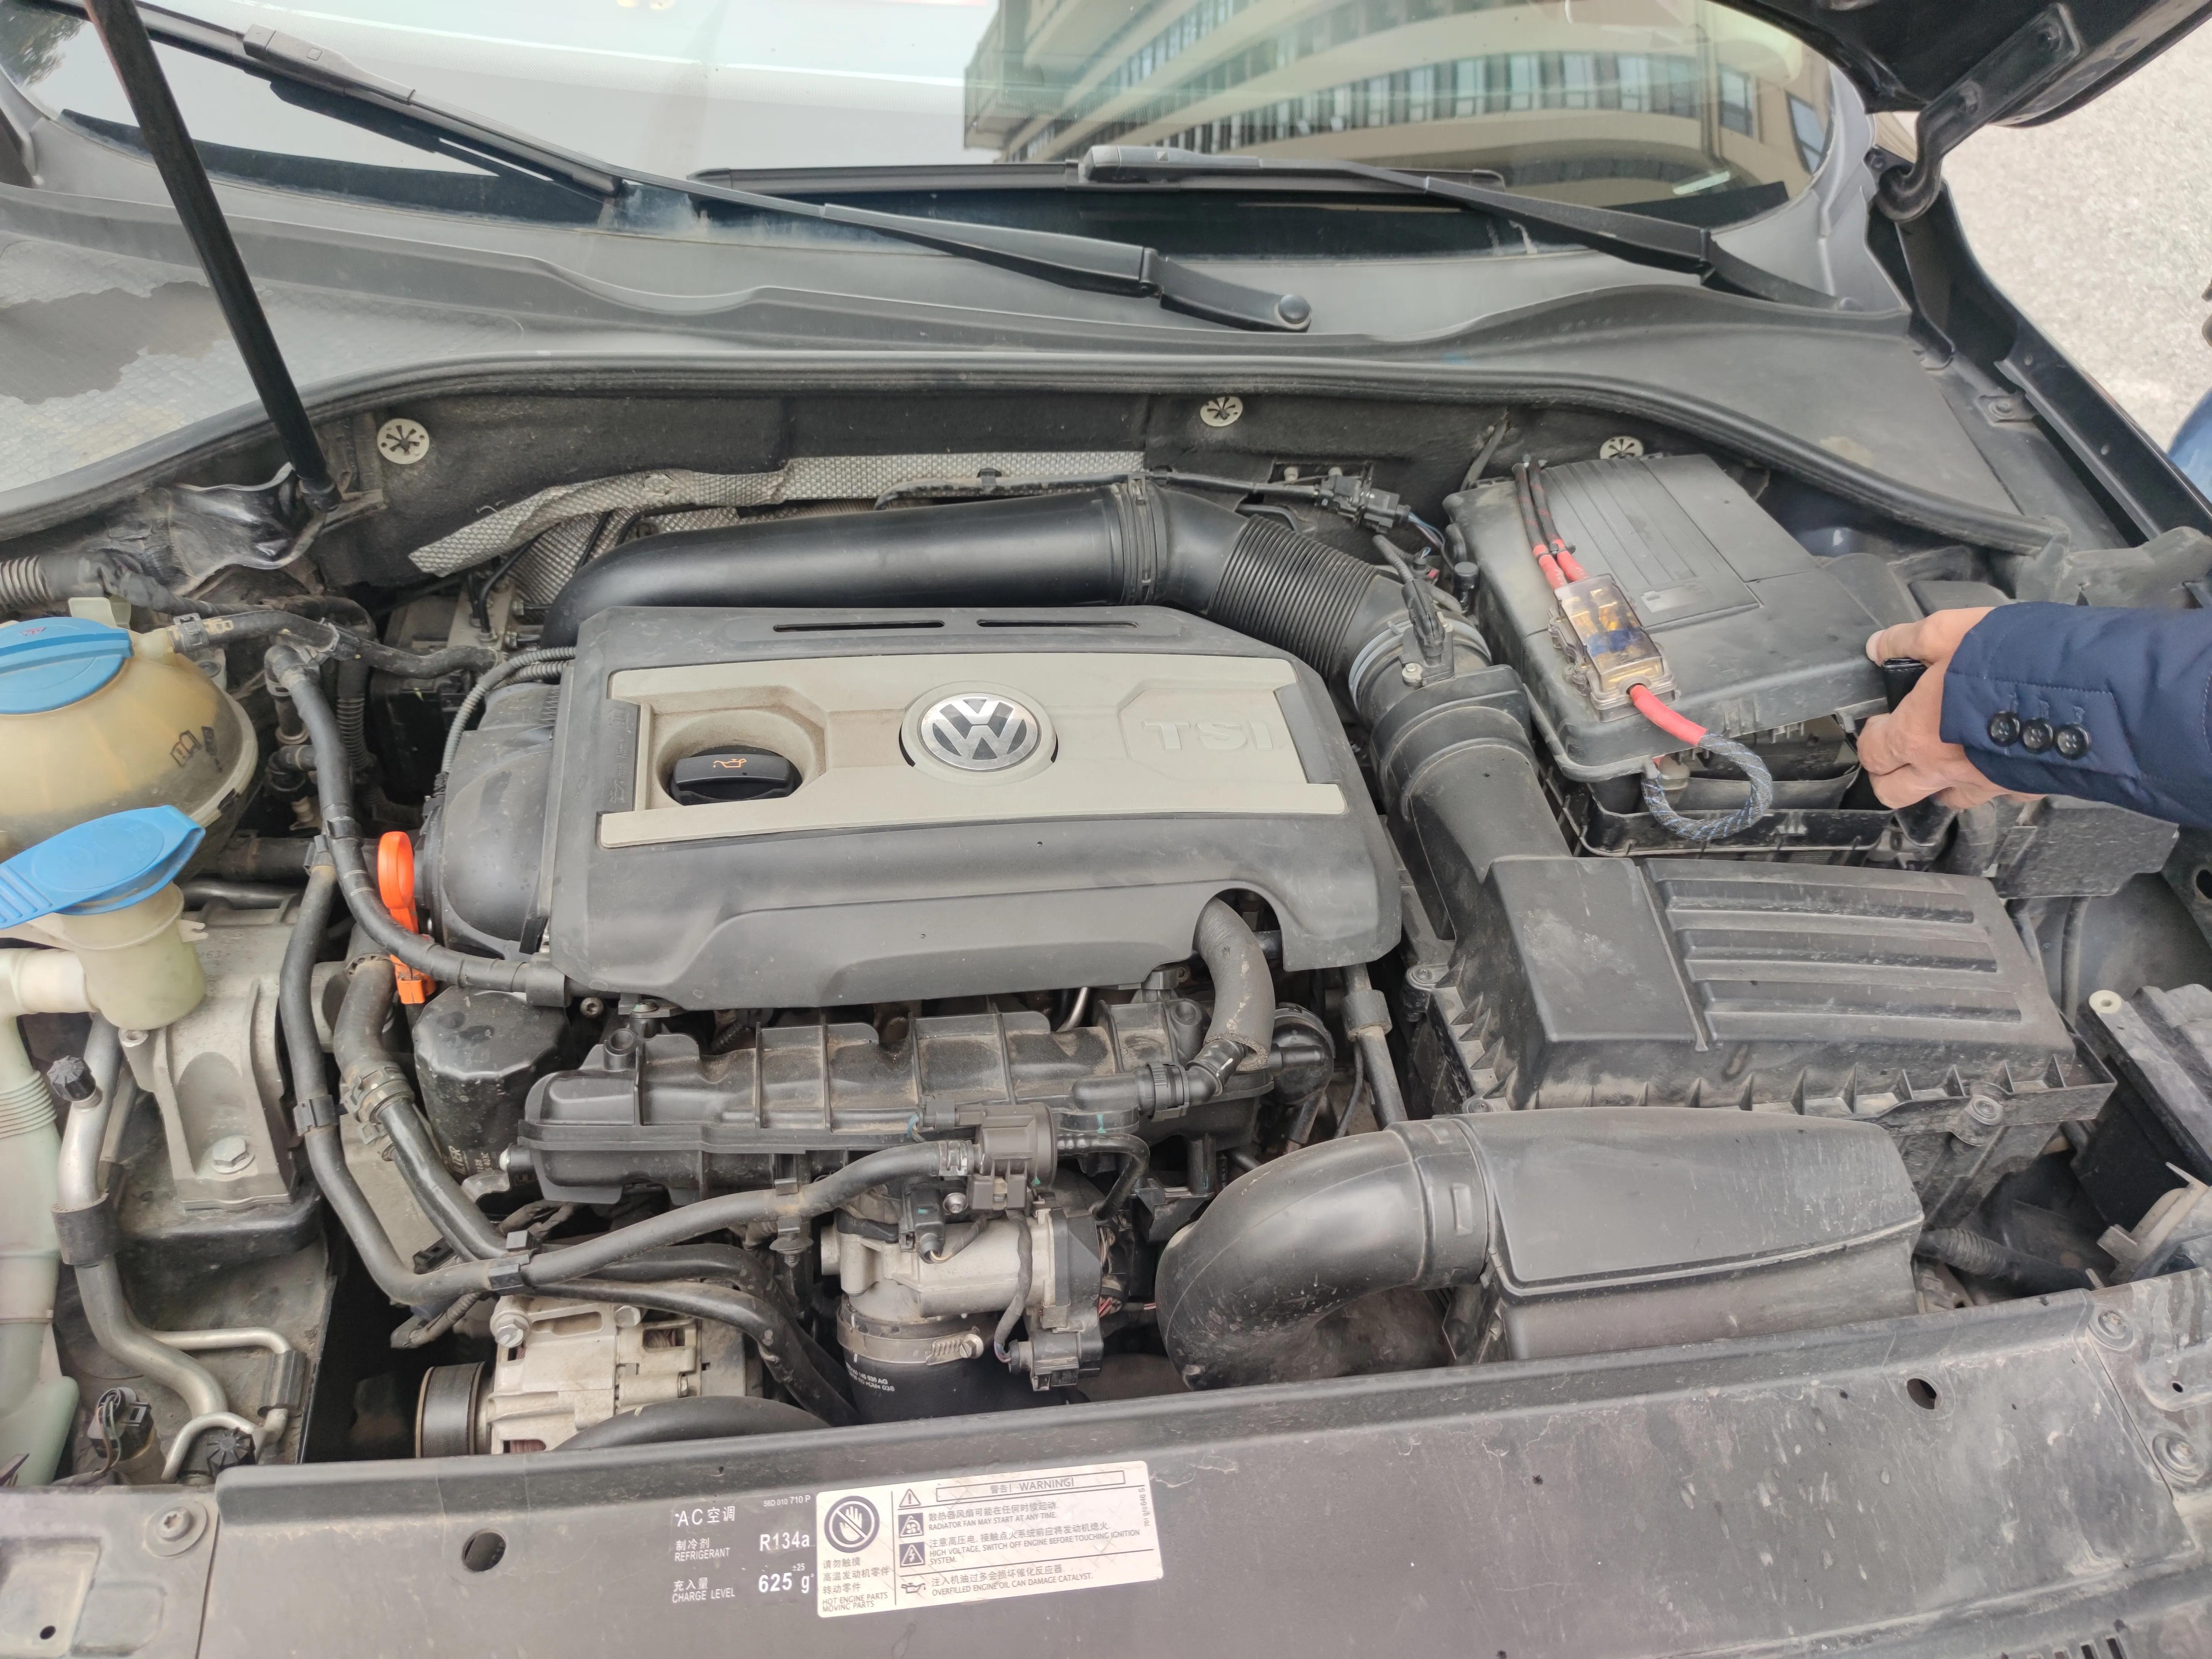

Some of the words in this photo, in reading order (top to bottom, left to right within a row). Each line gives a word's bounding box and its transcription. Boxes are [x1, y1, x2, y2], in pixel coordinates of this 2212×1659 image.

[1141, 720, 1274, 751] TSI
[1019, 1477, 1074, 1491] WARNING!
[789, 1496, 804, 1504] 710
[805, 1495, 811, 1503] P
[928, 1521, 962, 1531] RADIATOR
[993, 1515, 1014, 1524] START
[675, 1537, 710, 1551] 制冷剂
[760, 1531, 810, 1552] R134a
[930, 1549, 946, 1557] HIGH
[948, 1546, 980, 1555] VOLTAGE,
[983, 1543, 1007, 1551] SWITCH
[1024, 1538, 1048, 1547] ENGINE
[1049, 1536, 1073, 1544] BEFORE
[1075, 1532, 1109, 1542] TOUCHING
[1111, 1529, 1140, 1538] IGNITION
[674, 1547, 731, 1561] REFRIGERANT
[823, 1557, 861, 1569] 请勿触摸
[823, 1567, 890, 1582] 高温发动机零件
[673, 1577, 708, 1592] 充入量
[759, 1572, 792, 1593] 625
[801, 1575, 810, 1594] g
[823, 1582, 861, 1595] 转动零件
[932, 1585, 971, 1596] OVERFILLED
[973, 1583, 998, 1592] ENGINE
[1012, 1579, 1026, 1587] CAN
[1028, 1576, 1057, 1586] DAMAGE
[1058, 1572, 1093, 1583] CATALYST.
[672, 1589, 707, 1604] CHARGE
[711, 1587, 736, 1599] LEVEL
[840, 1594, 865, 1604] ENGINE
[867, 1592, 888, 1600] PARTS
[822, 1603, 850, 1612] MOVING
[853, 1600, 875, 1609] PARTS
